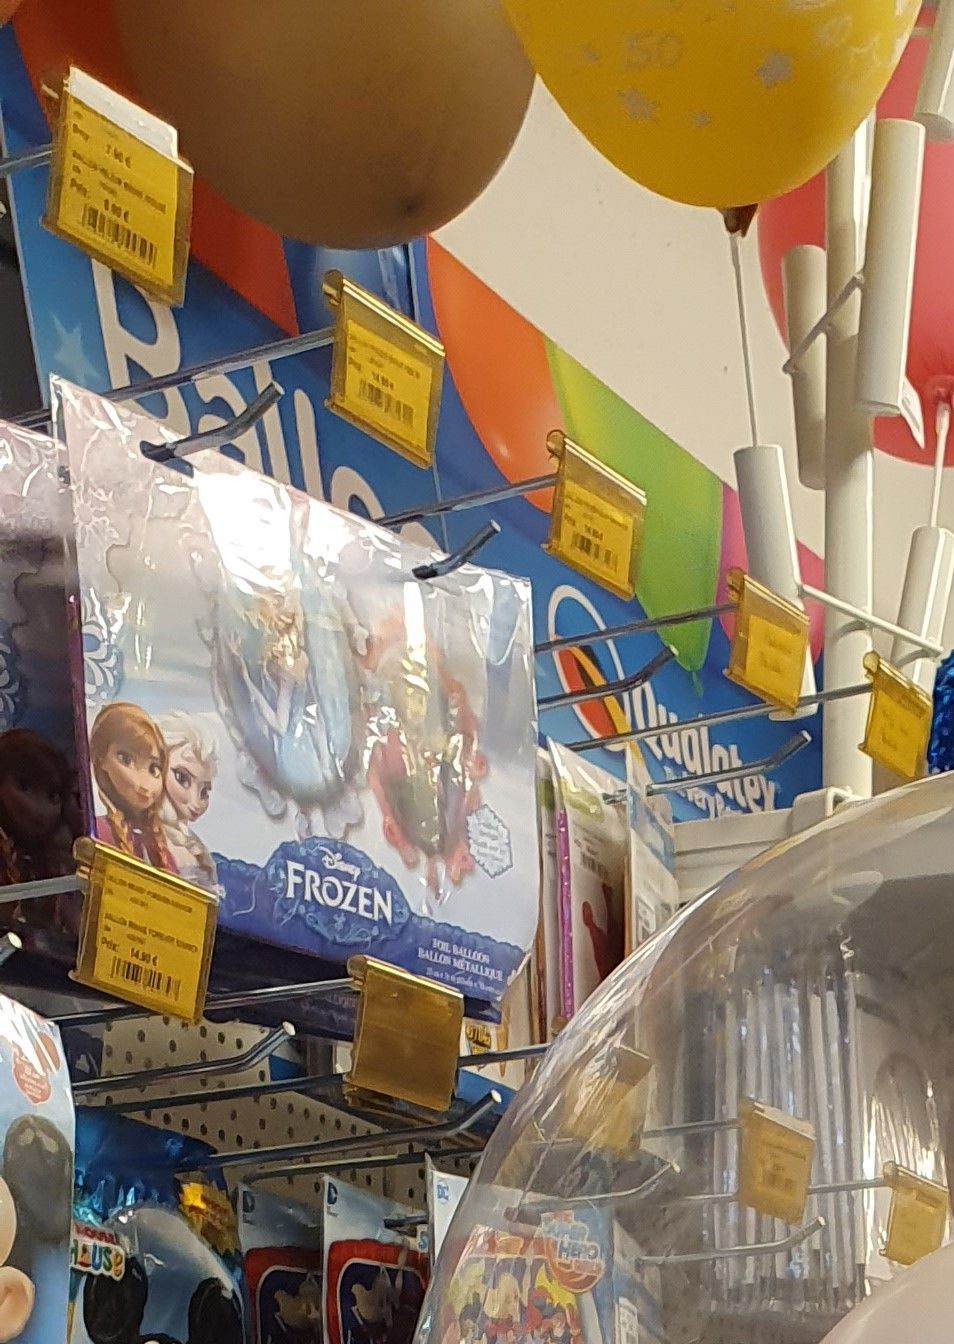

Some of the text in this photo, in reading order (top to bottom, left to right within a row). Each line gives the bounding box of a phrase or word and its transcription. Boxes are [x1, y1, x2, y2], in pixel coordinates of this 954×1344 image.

[285, 859, 393, 927] FROZEN
[417, 947, 451, 968] BALLON
[452, 944, 490, 964] BALLOON
